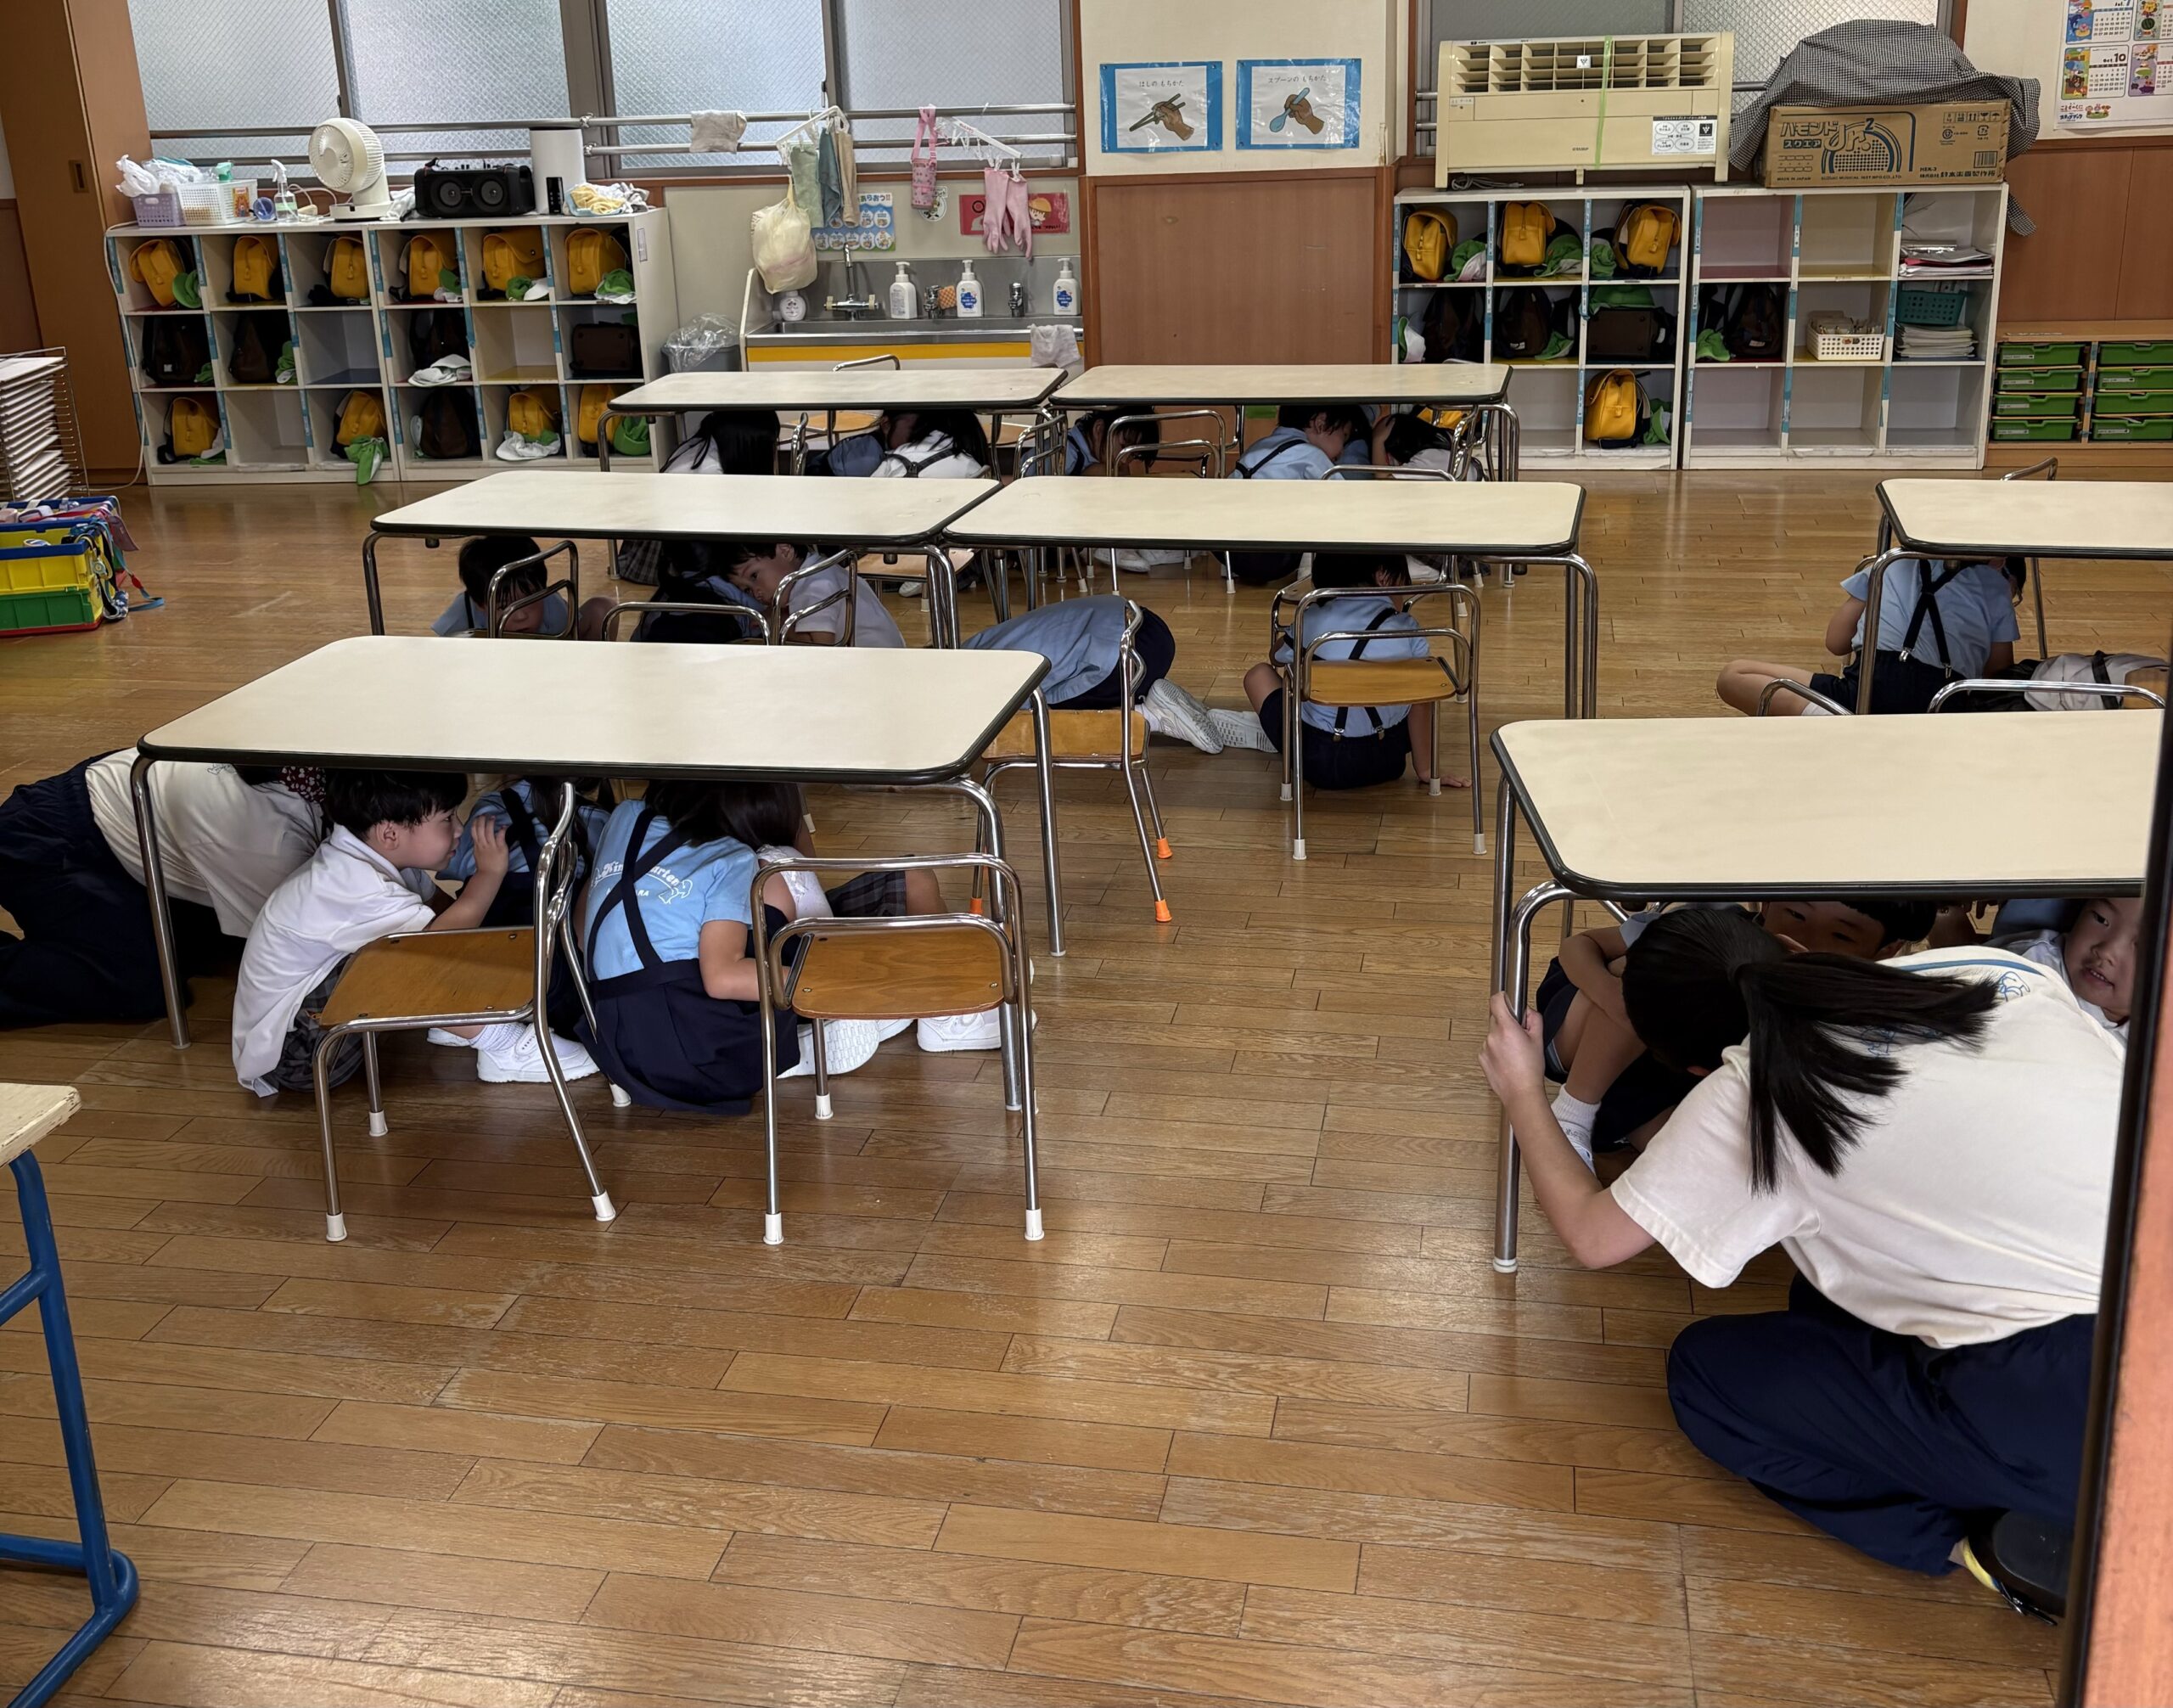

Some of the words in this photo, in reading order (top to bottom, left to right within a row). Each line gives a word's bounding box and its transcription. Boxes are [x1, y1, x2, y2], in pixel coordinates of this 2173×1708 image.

[2114, 53, 2126, 62] 10
[1780, 121, 1840, 137] ハモンド
[1864, 117, 1875, 131] 2
[1783, 139, 1822, 149] スクエア
[601, 860, 680, 887] Kinarten
